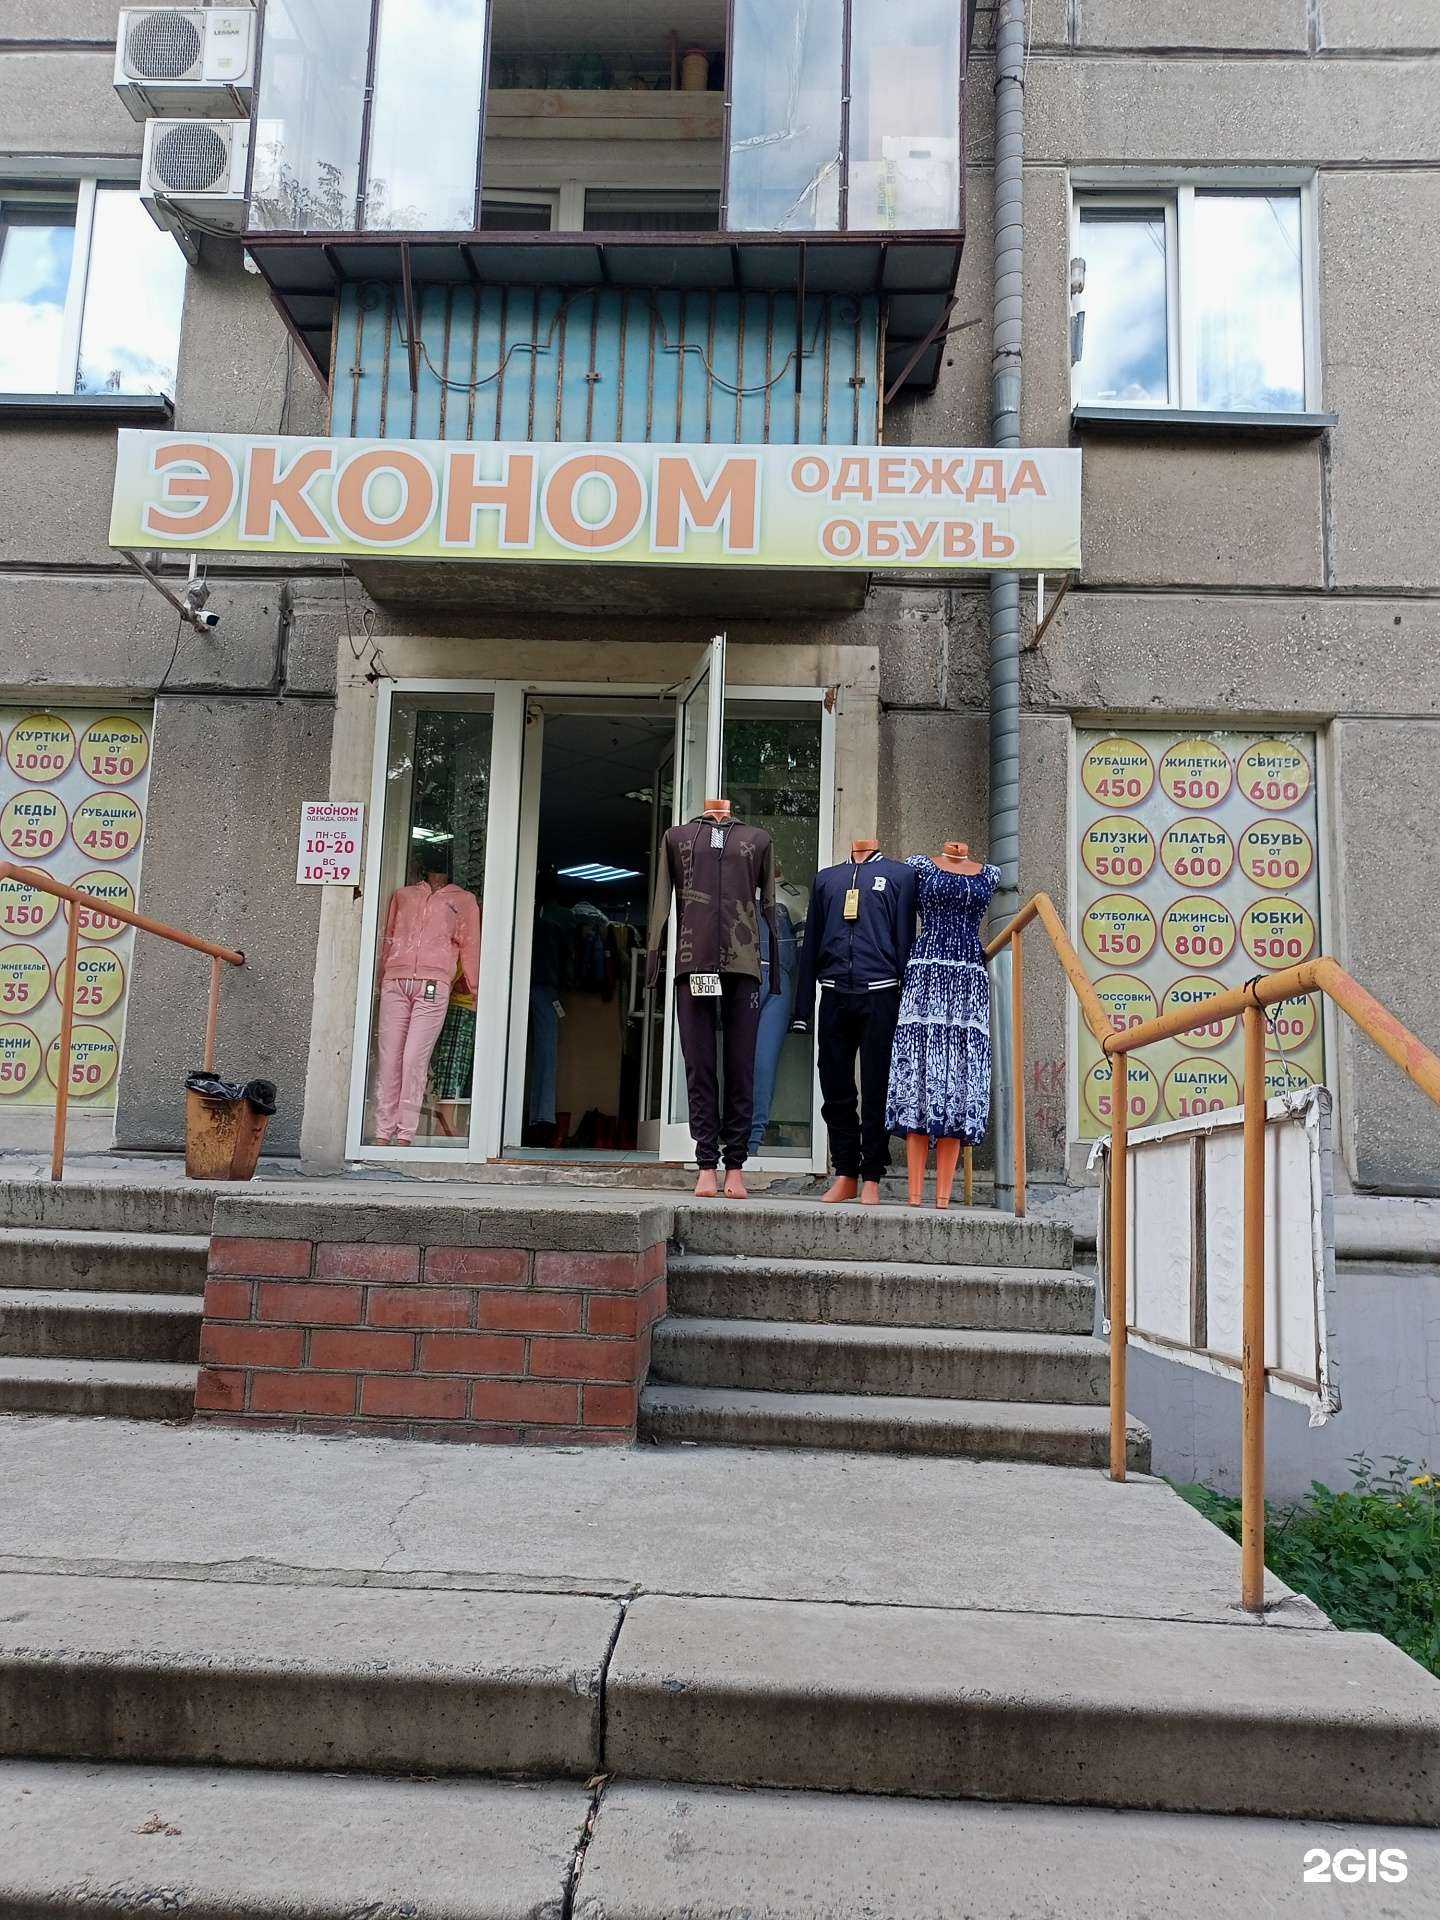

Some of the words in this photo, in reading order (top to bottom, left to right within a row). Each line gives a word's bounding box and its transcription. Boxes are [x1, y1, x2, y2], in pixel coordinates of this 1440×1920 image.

[790, 455, 1048, 500] ОДЕЖДА
[145, 442, 758, 551] ЭКОНОМ
[822, 518, 1017, 560] ОБУВЬ
[16, 731, 70, 742] КУРТКИ
[88, 733, 143, 744] ШАРФЫ
[15, 754, 64, 769] 1000
[92, 757, 134, 775] 150
[1089, 757, 1148, 767] РУБАШКИ
[1165, 758, 1227, 768] ЖИЛЕТКИ
[1095, 779, 1142, 798] 450
[1173, 780, 1220, 799] 500
[1249, 781, 1298, 801] 600
[14, 805, 56, 816] КЕДЫ
[81, 809, 137, 818] РУБАШКИ
[307, 806, 358, 815] ЭКОНОМ
[11, 829, 53, 847] 250
[83, 830, 129, 848] 450
[315, 831, 347, 839] ПН-СБ
[1089, 832, 1148, 844] БЛУЗКИ
[1168, 832, 1226, 844] ПЛАТЬЯ
[1248, 833, 1303, 845] ОБУВЬ
[306, 840, 354, 853] 10-20
[322, 858, 336, 866] ВС
[1095, 857, 1143, 876] 500
[1174, 857, 1222, 877] 600
[1251, 859, 1300, 879] 500
[304, 866, 351, 880] 10-19
[0, 883, 42, 892] ПАРФ
[5, 906, 44, 924] 150
[78, 910, 121, 929] 500
[1089, 912, 1151, 922] ФУТБОЛКА
[1168, 913, 1229, 924] ДЖИНСЫ
[1251, 911, 1303, 924] ЮБКИ
[1098, 934, 1141, 953] 150
[1174, 936, 1224, 956] 800
[1253, 938, 1302, 958] 500
[77, 961, 116, 972] ОСКИ
[76, 986, 103, 1005] 25
[1097, 993, 1151, 1002] РОССОВКИ
[1171, 991, 1216, 1003] ЗОНТ
[1107, 1014, 1143, 1033] 50
[1184, 1021, 1223, 1037] 50
[0, 1038, 31, 1049] ЕМНИ
[0, 1062, 27, 1082] 50
[71, 1064, 101, 1084] 50
[1094, 1070, 1149, 1082] СУКИ
[1174, 1072, 1228, 1084] ШАПКИ
[1264, 1075, 1308, 1088] РЮКИ
[1099, 1095, 1146, 1116] 50
[1178, 1097, 1225, 1118] 100
